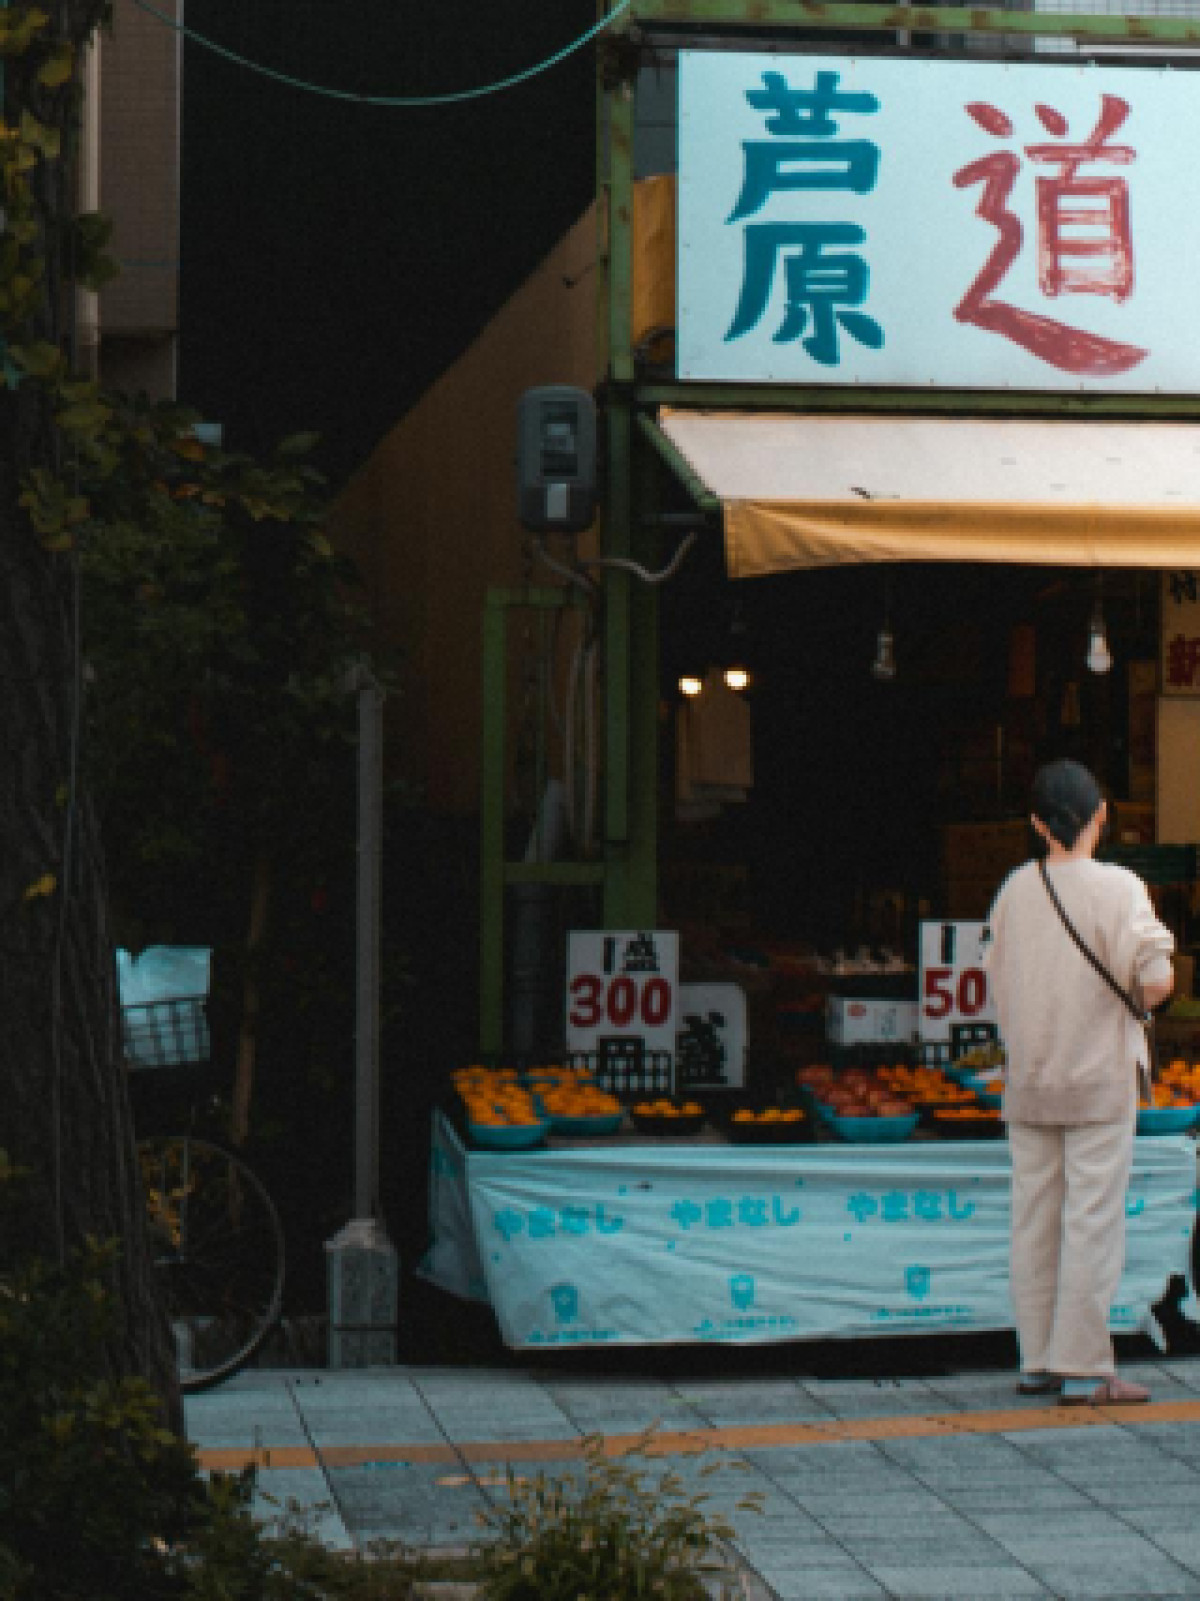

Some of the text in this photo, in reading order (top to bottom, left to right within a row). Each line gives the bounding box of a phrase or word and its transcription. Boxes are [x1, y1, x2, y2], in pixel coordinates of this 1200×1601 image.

[724, 70, 885, 367] 芦原
[568, 973, 673, 1028] 300
[923, 967, 988, 1021] 50
[669, 1195, 802, 1231] やまなし
[846, 1190, 976, 1223] やまなし
